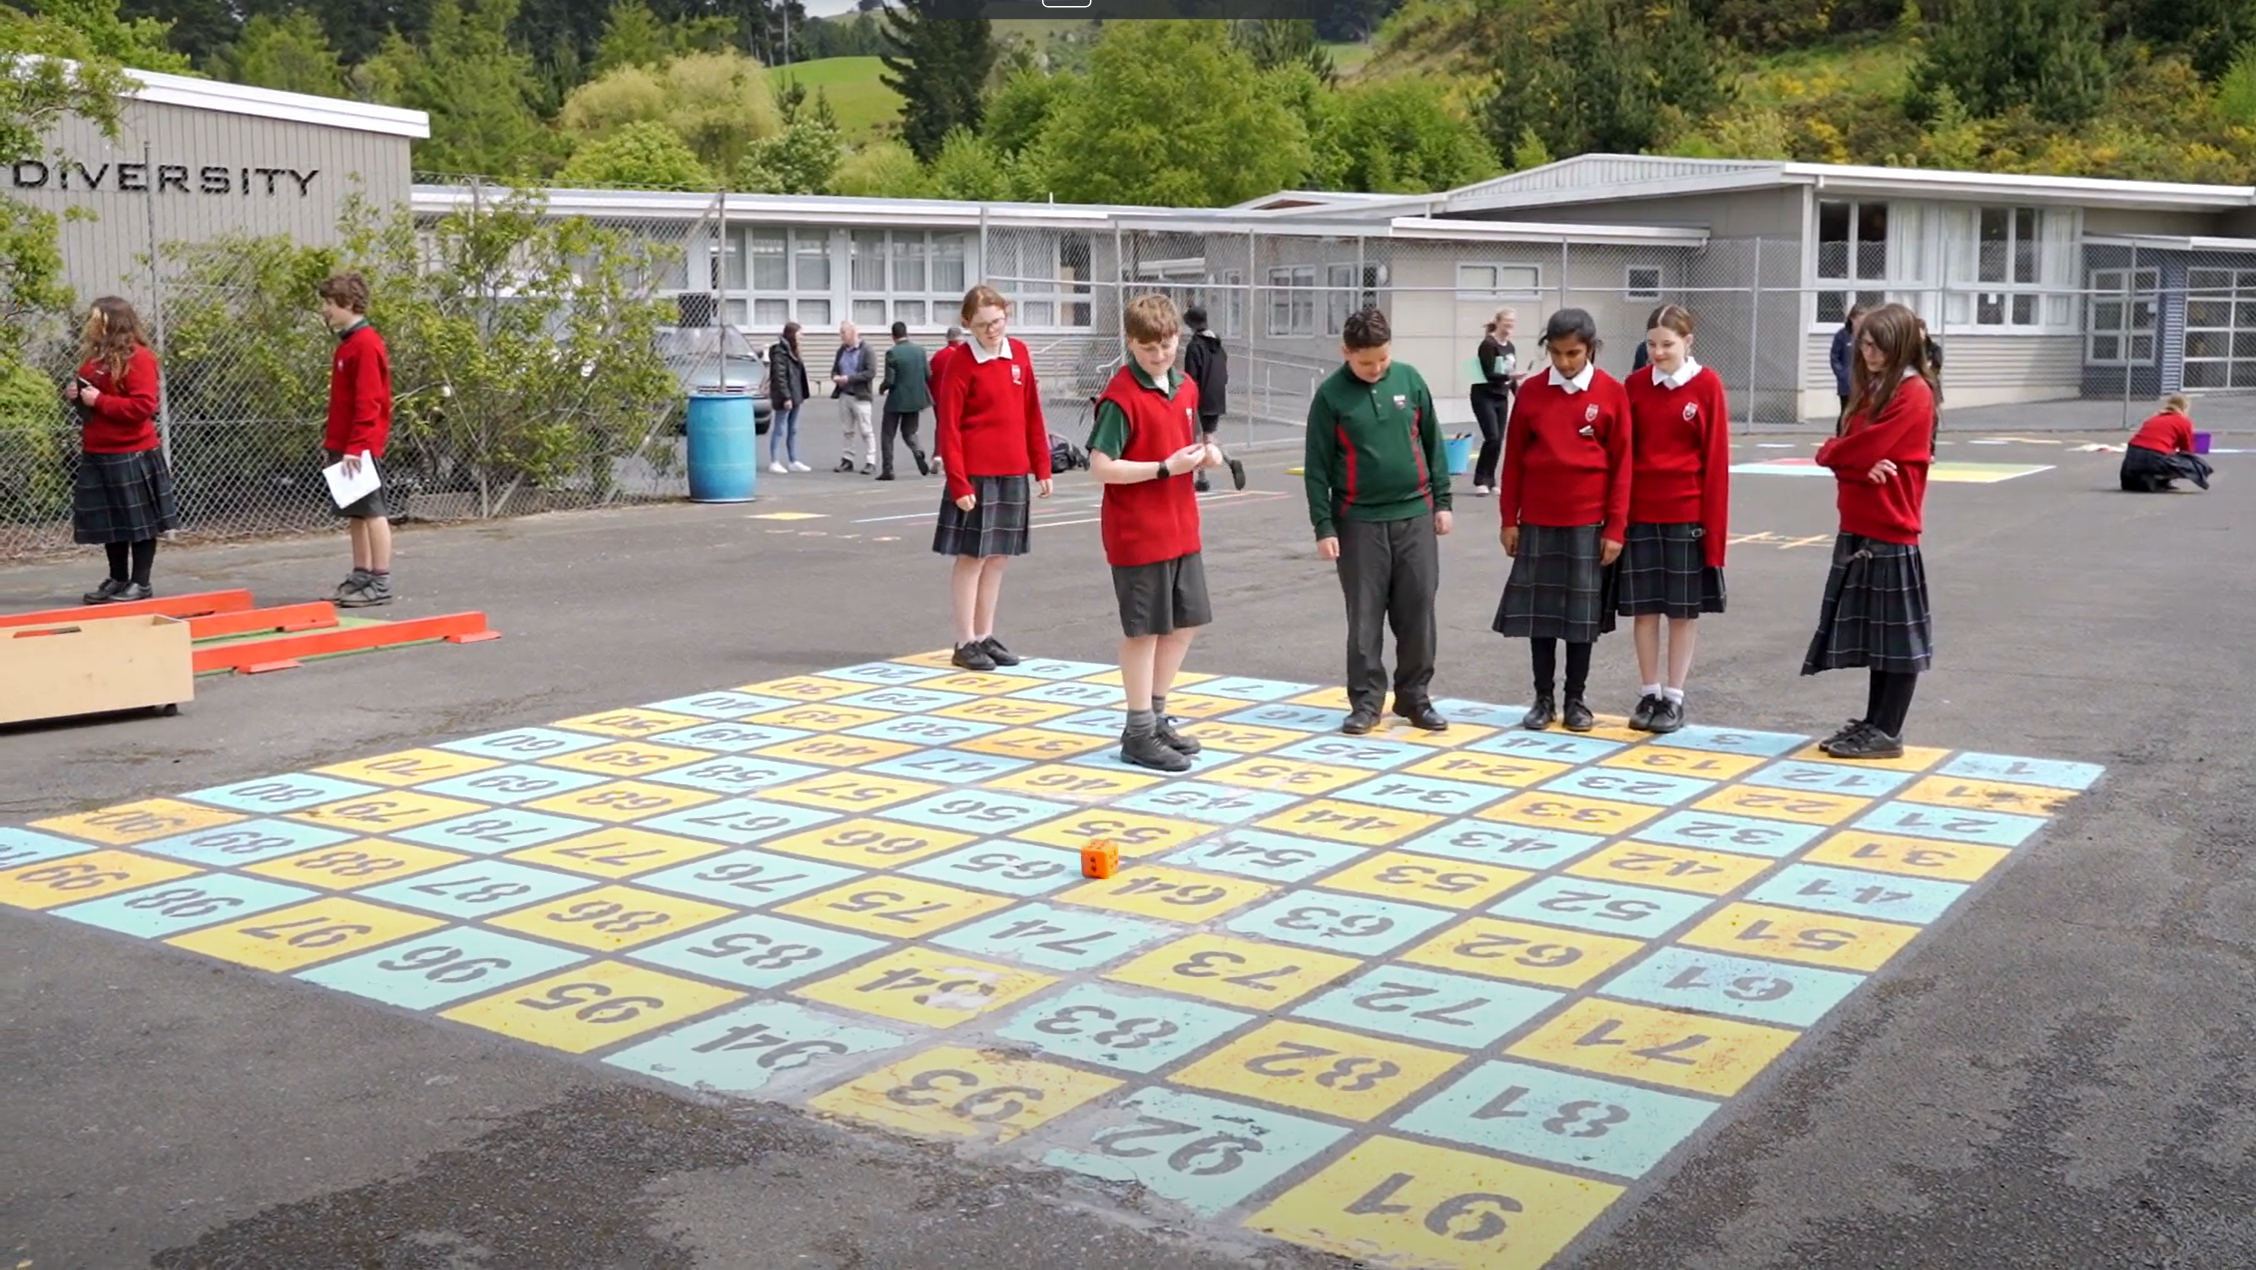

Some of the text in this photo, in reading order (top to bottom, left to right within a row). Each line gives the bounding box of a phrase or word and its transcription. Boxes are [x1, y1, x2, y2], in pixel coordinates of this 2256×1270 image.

[12, 159, 321, 197] DIVERSITY
[589, 716, 671, 730] 50
[483, 735, 565, 751] 60
[994, 737, 1082, 751] 37
[1304, 744, 1400, 760] 25
[1501, 738, 1576, 753] 14
[363, 758, 454, 777] 70
[583, 751, 669, 767] 59
[902, 758, 996, 772] 47
[1439, 759, 1533, 777] 24
[1642, 754, 1722, 771] 13
[468, 776, 558, 792] 69
[687, 765, 778, 783] 58
[1026, 774, 1120, 790] 46
[1235, 766, 1332, 784] 35
[1782, 769, 1869, 786] 12
[229, 782, 326, 802] 80
[797, 783, 897, 801] 57
[1372, 784, 1470, 803] 34
[1578, 777, 1676, 795] 23
[332, 801, 430, 823] 79
[577, 791, 672, 810] 68
[929, 800, 1029, 821] 56
[1150, 791, 1253, 810] 45
[1521, 802, 1621, 822] 33
[1734, 794, 1836, 814] 22
[445, 820, 547, 843] 78
[684, 812, 790, 831] 67
[1294, 810, 1396, 830] 44
[1895, 812, 1998, 834] 21
[190, 832, 295, 854] 89
[822, 831, 928, 854] 66
[1062, 821, 1170, 844] 55
[1450, 832, 1557, 853] 43
[1675, 822, 1783, 845] 32
[294, 852, 404, 876] 88
[552, 843, 666, 866] 77
[1204, 841, 1316, 867] 54
[1609, 853, 1723, 876] 42
[1850, 843, 1956, 867] 31
[15, 864, 131, 891] 99
[694, 864, 808, 892] 76
[950, 853, 1066, 880] 65
[409, 877, 531, 902] 87
[1374, 866, 1488, 892] 53
[1109, 877, 1226, 905] 64
[1797, 879, 1913, 904] 41
[124, 889, 244, 917] 98
[828, 892, 951, 923] 75
[1538, 890, 1660, 921] 52
[547, 901, 670, 932] 86
[1274, 907, 1394, 937] 63
[238, 917, 371, 947] 97
[989, 920, 1117, 955] 74
[1735, 920, 1857, 951] 51
[686, 934, 822, 969] 85
[1454, 934, 1582, 967] 62
[378, 947, 511, 983] 96
[1173, 951, 1301, 991] 73
[1663, 966, 1793, 1001] 61
[516, 983, 663, 1023] 95
[1353, 982, 1491, 1026] 72
[1034, 1006, 1178, 1048] 83
[1573, 1019, 1710, 1065] 71
[1244, 1042, 1400, 1091] 82
[886, 1068, 1045, 1122] 93
[1470, 1086, 1630, 1138] 81
[1091, 1115, 1264, 1176] 92
[1344, 1173, 1522, 1241] 91
